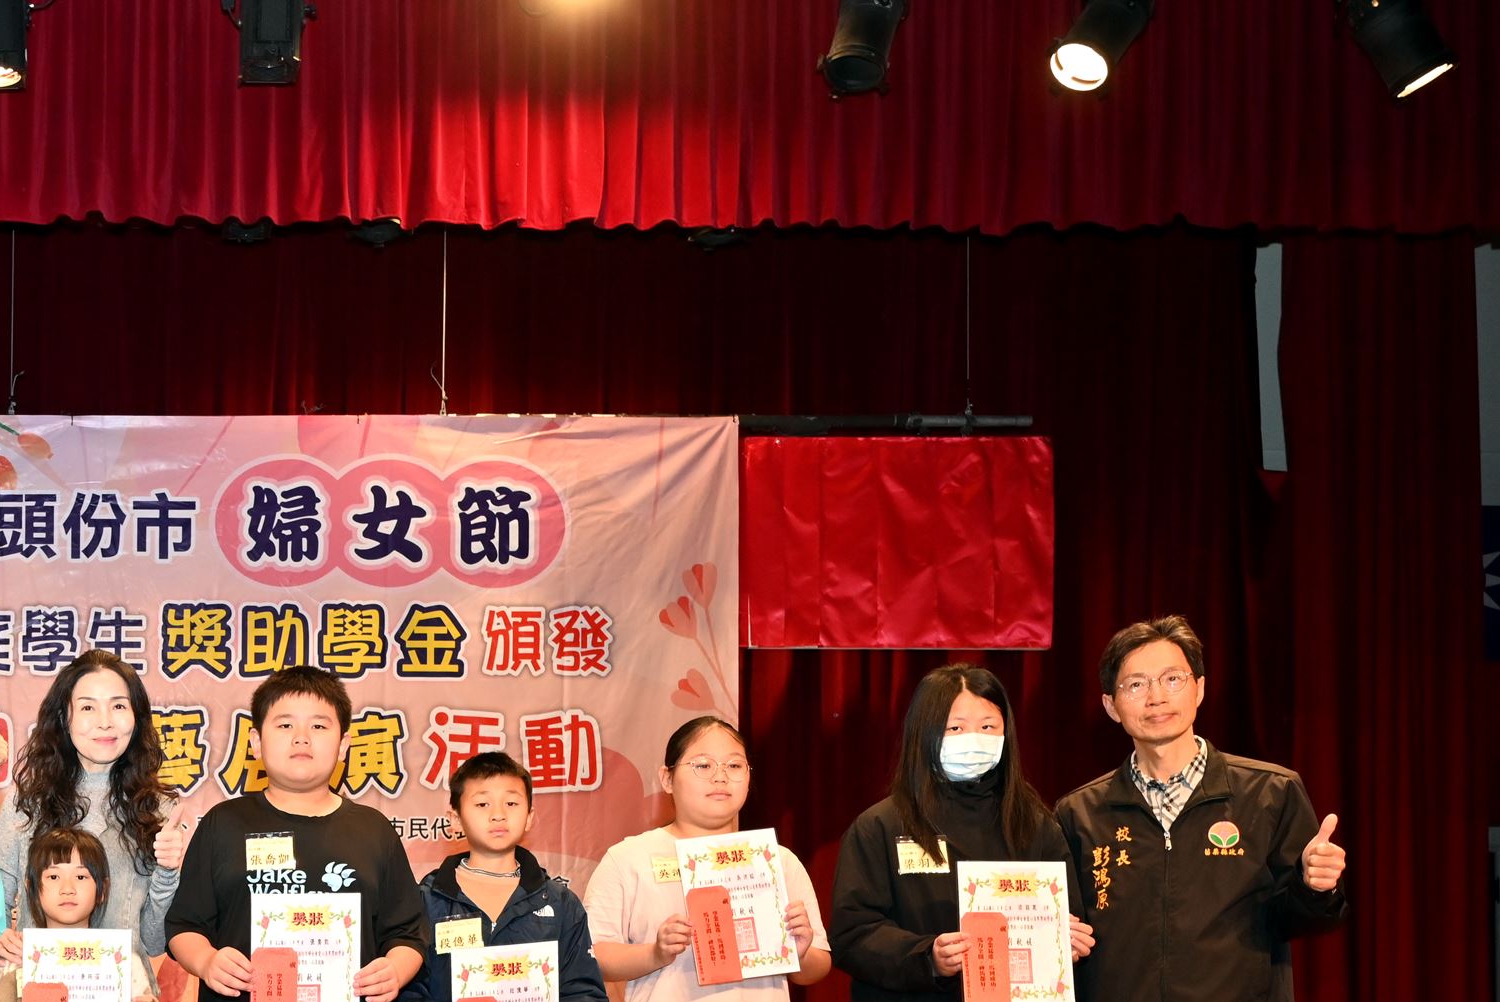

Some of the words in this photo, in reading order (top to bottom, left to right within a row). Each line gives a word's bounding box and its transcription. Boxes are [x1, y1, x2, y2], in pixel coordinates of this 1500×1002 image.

[1115, 826, 1132, 867] 校長
[1092, 845, 1111, 910] 彭鴻原
